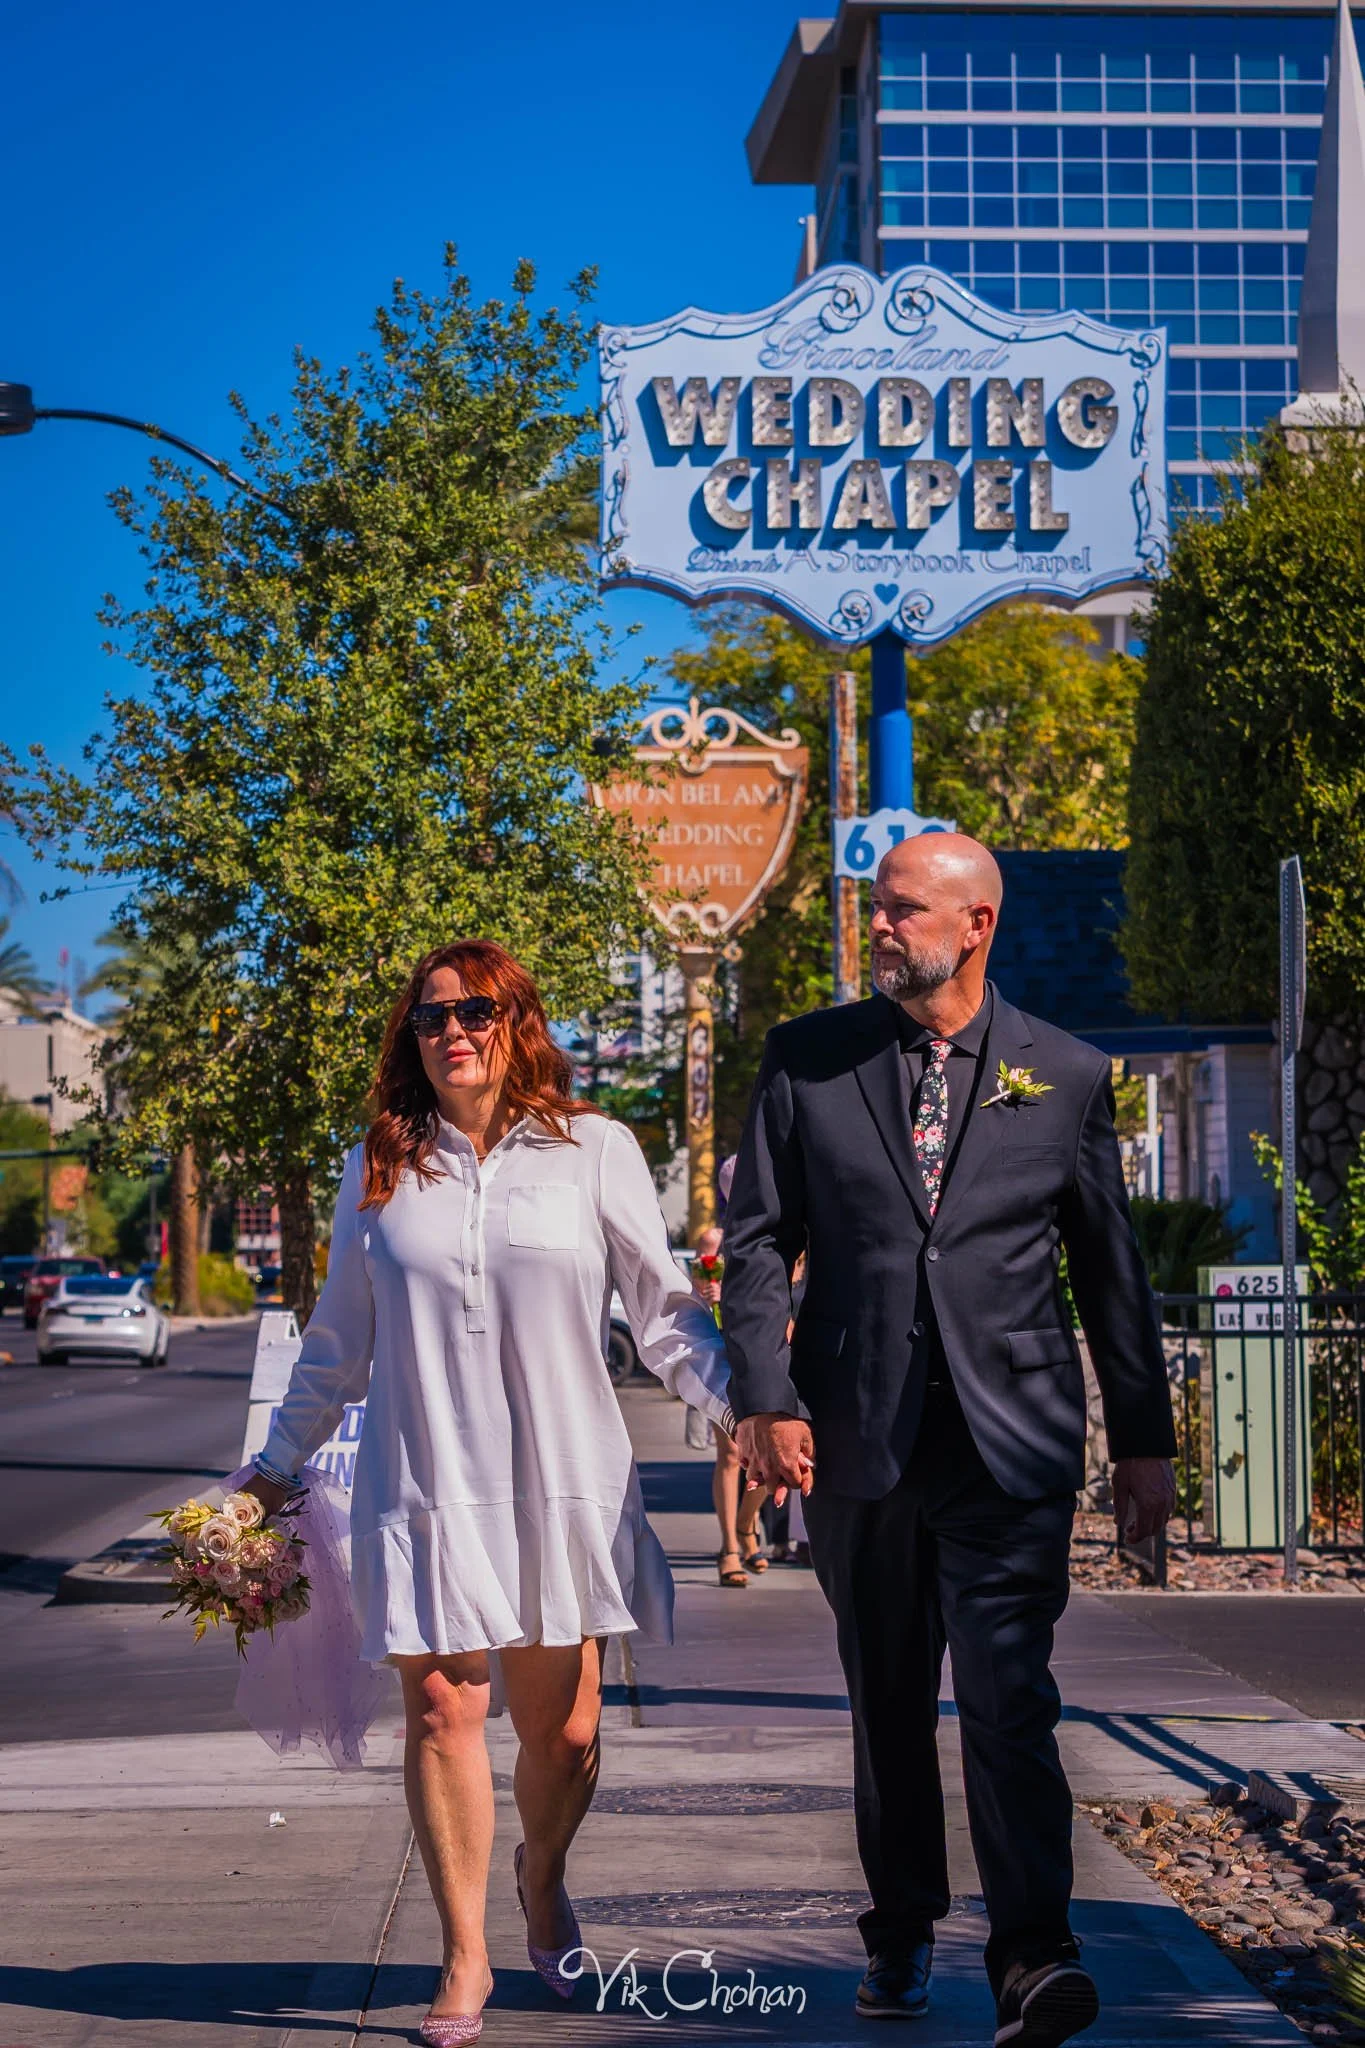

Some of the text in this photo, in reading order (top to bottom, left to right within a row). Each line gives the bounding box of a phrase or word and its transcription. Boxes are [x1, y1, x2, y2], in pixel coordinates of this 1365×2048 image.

[758, 317, 1010, 371] Graceland
[650, 376, 1119, 449] WEDDING
[702, 457, 1071, 532] CHAPEL
[784, 540, 821, 573] A
[827, 540, 975, 578] Storybook
[979, 538, 1092, 580] Chapel
[609, 783, 785, 806] MON BEL AMI
[652, 864, 749, 886] HAPEL
[1237, 1275, 1279, 1294] 625
